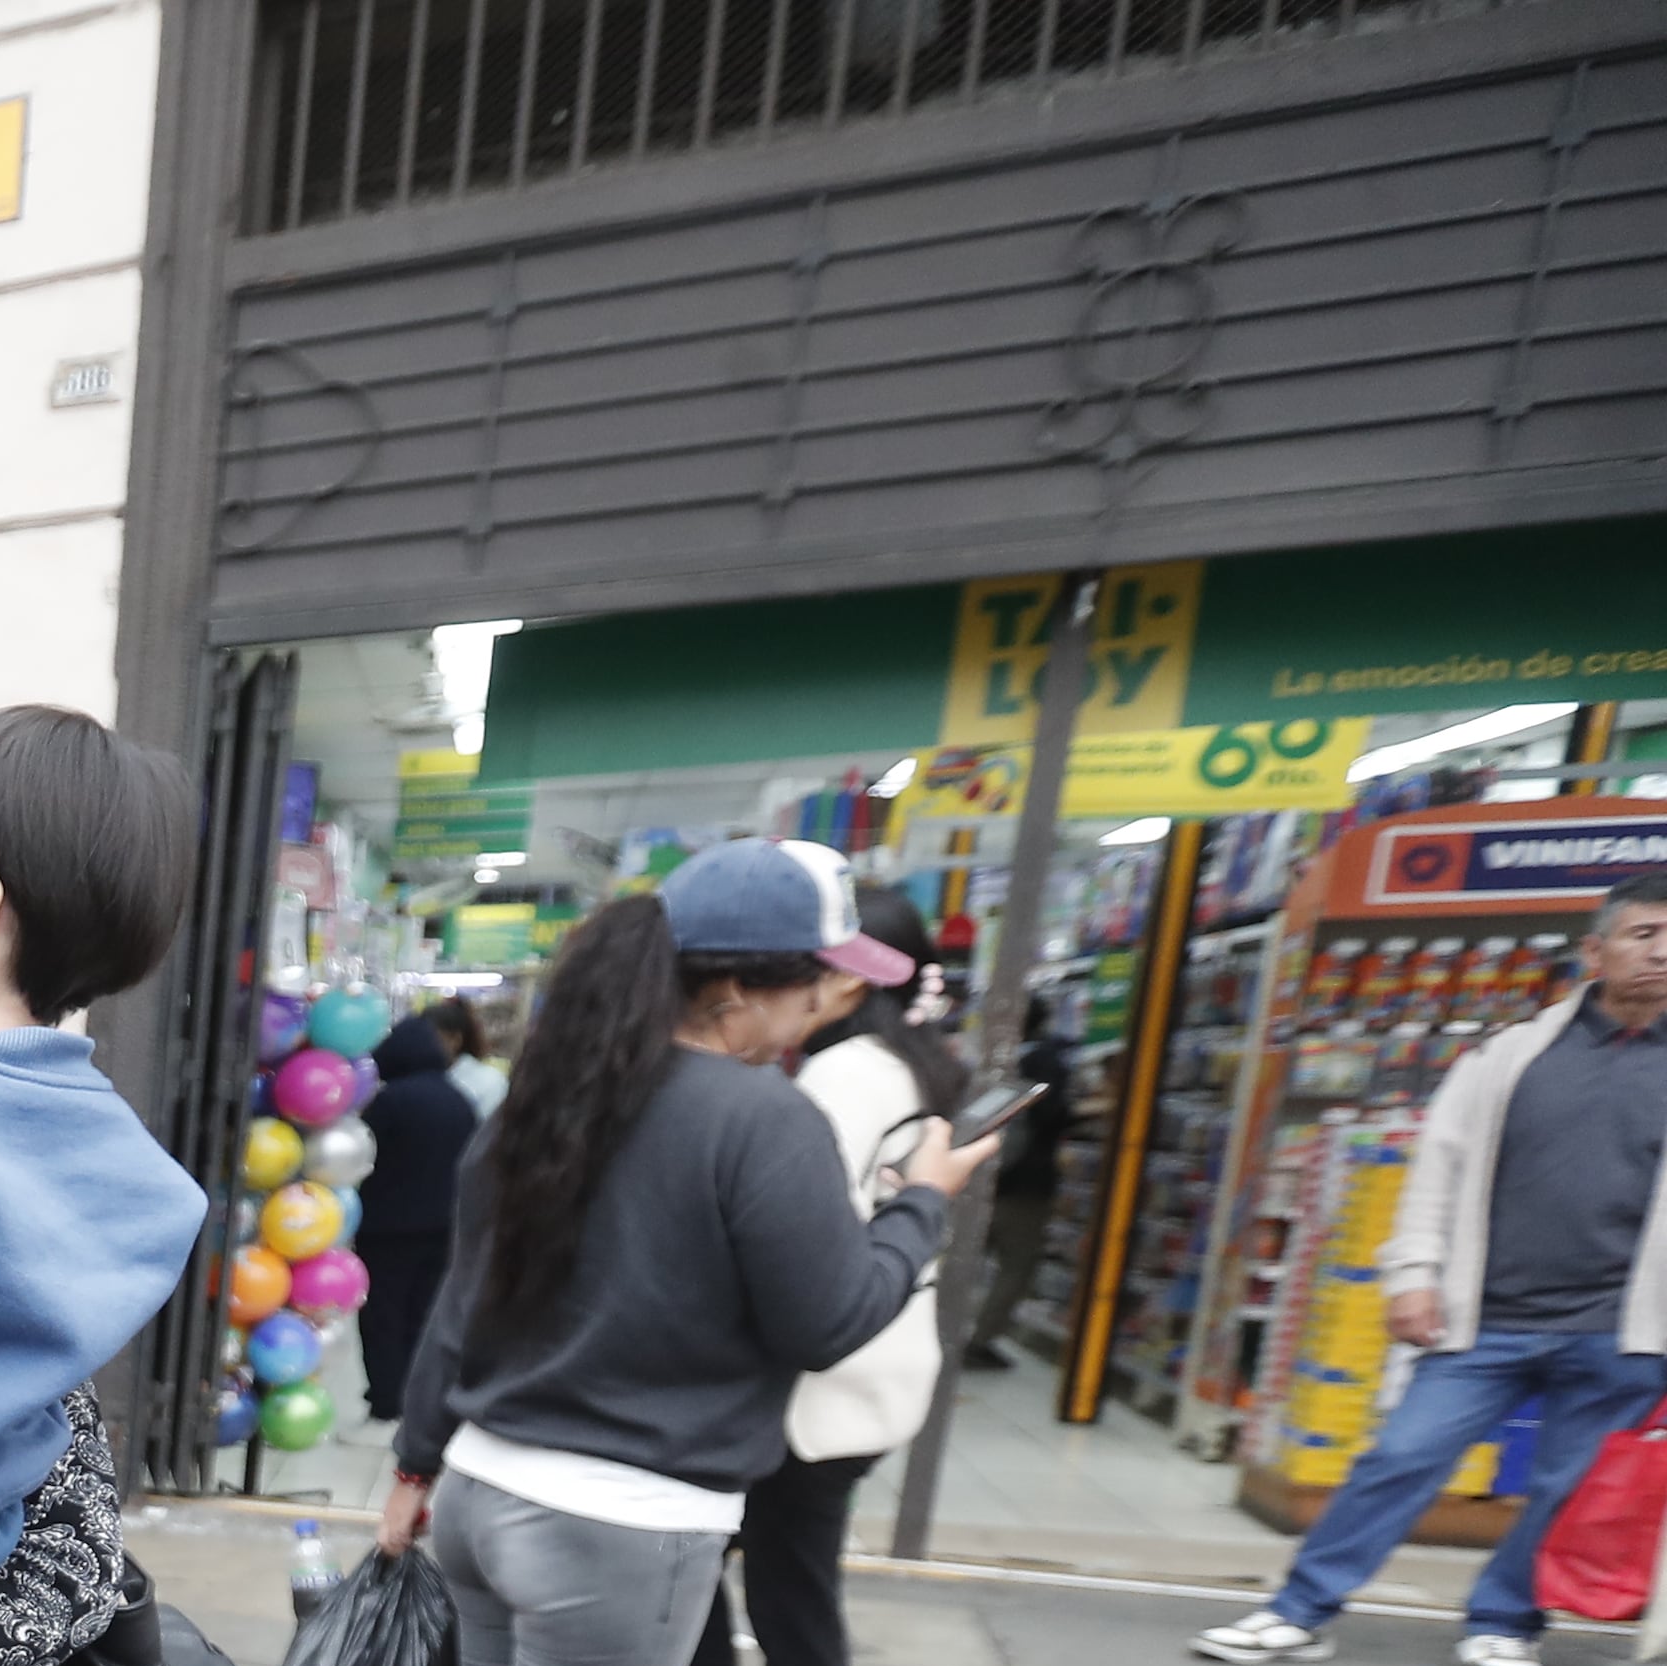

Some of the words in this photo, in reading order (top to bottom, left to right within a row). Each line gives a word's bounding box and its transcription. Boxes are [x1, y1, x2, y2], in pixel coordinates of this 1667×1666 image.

[979, 579, 1145, 649] TI
[1271, 668, 1325, 699] La
[1329, 653, 1512, 693] emoción
[1518, 649, 1573, 681] de
